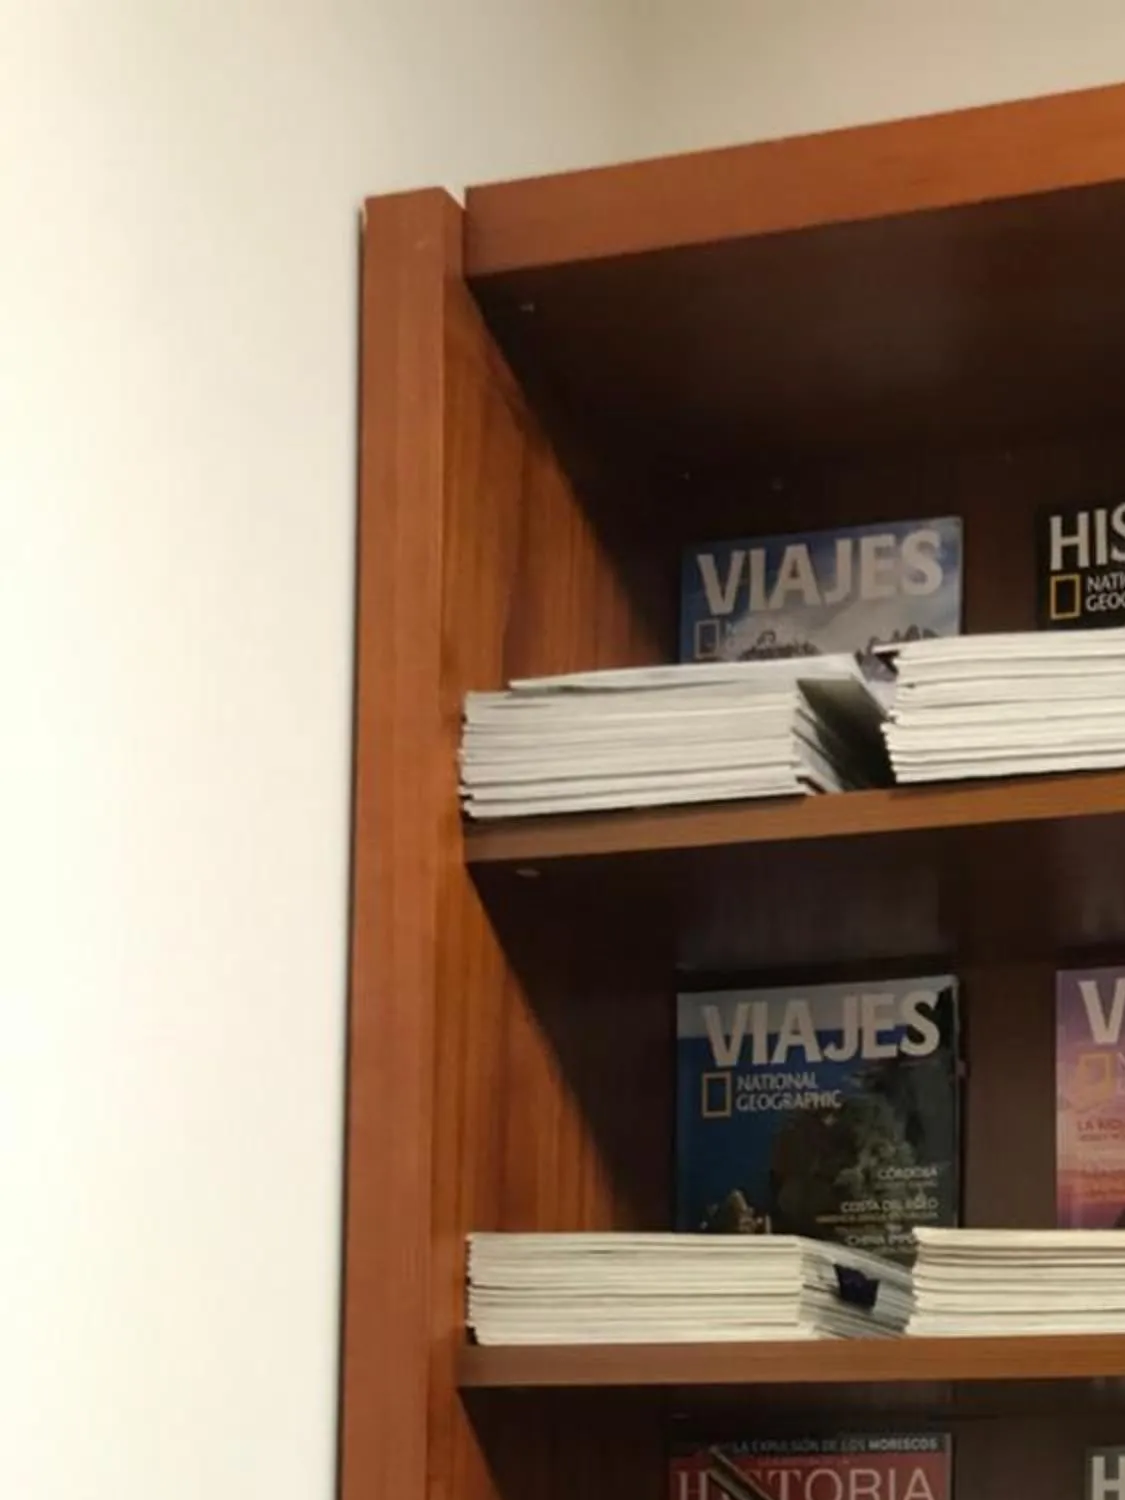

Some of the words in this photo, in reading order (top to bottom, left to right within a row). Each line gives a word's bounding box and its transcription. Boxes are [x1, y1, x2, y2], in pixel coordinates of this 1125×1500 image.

[697, 529, 944, 616] VIAJES
[702, 989, 941, 1068] VIAJES
[736, 1071, 818, 1092] NATIONAL
[735, 1089, 843, 1112] GEOGRAPHIC
[868, 1436, 938, 1451] MORISCOS
